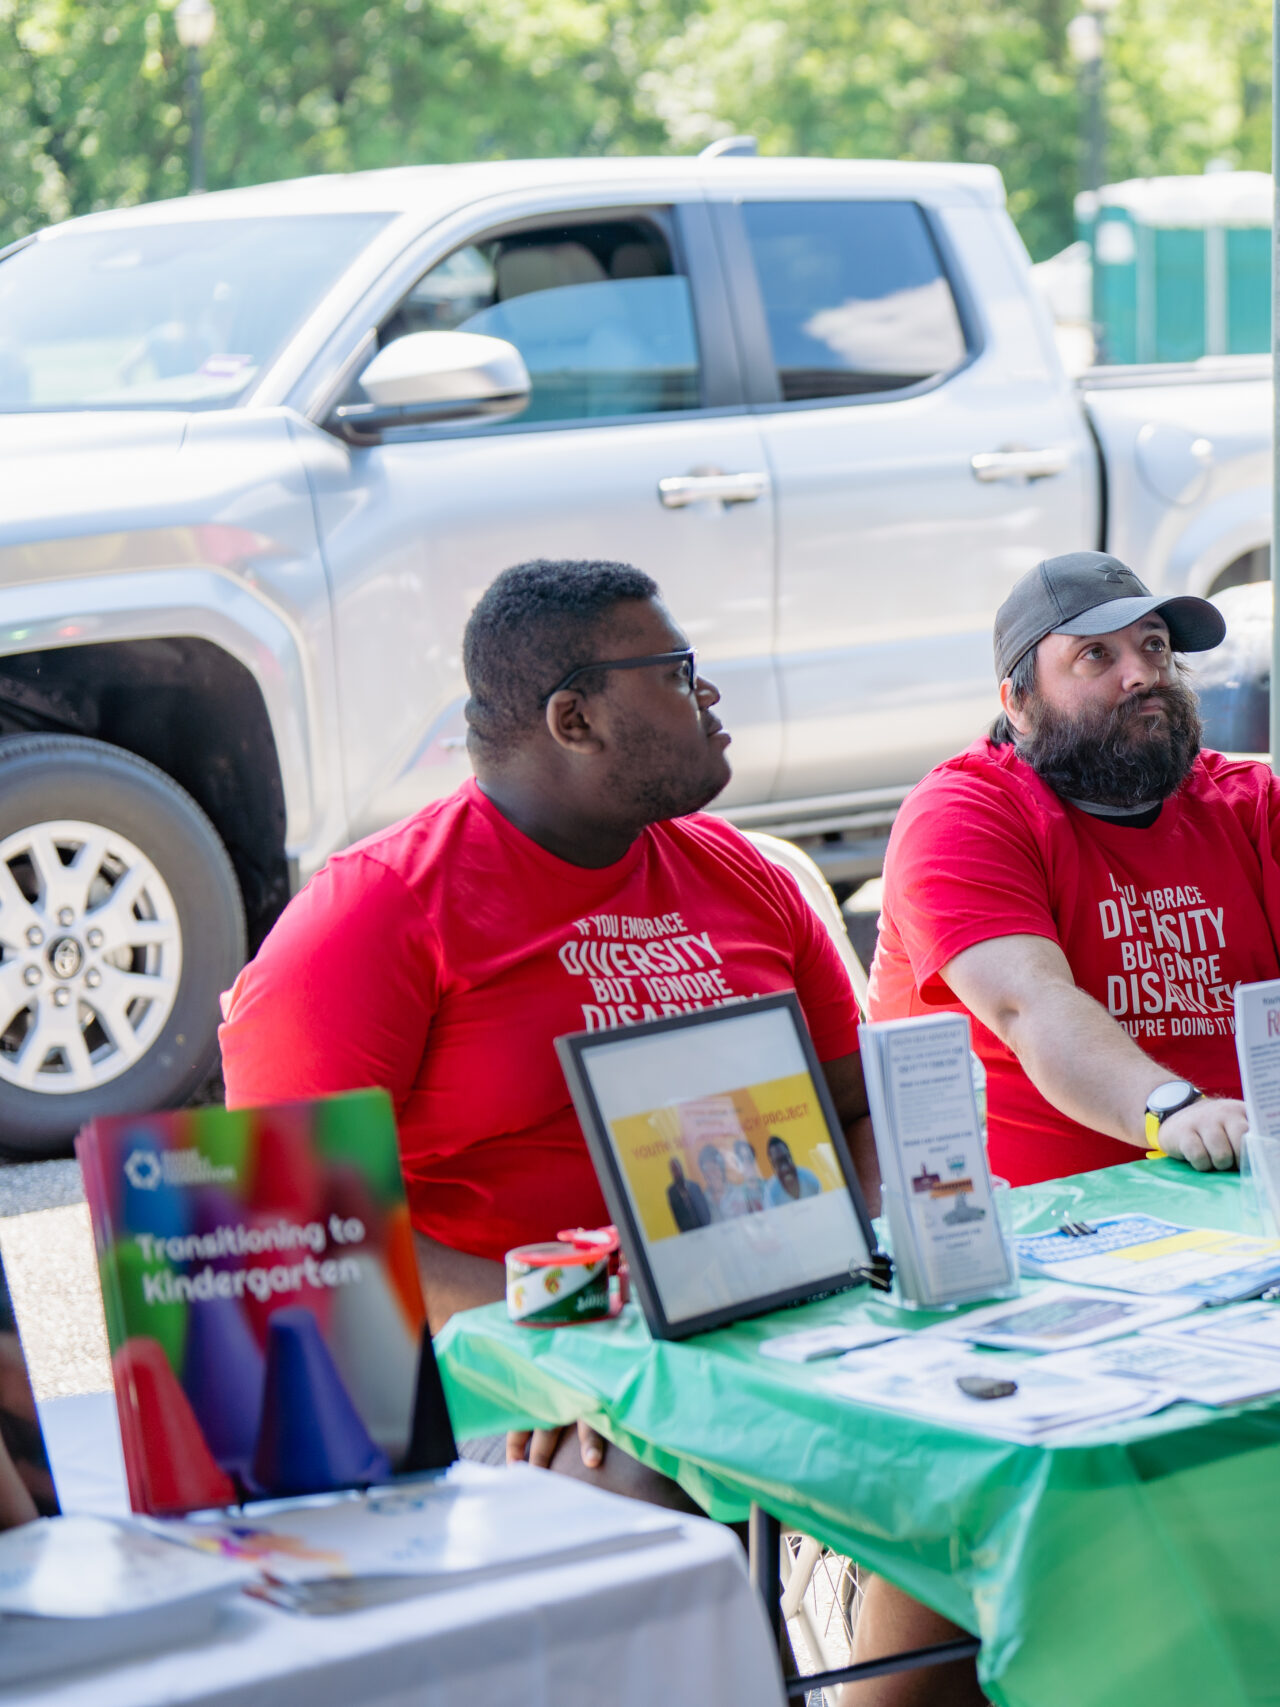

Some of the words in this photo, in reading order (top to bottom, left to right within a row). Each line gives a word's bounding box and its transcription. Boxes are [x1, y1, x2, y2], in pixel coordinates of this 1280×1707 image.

[572, 918, 590, 936] IF
[588, 914, 619, 938] YOU
[621, 911, 689, 940] EMBRACE
[558, 931, 724, 977] DIVERSITY
[588, 977, 638, 1004] BUT
[640, 968, 734, 1002] IGNORE
[1120, 1018, 1166, 1038] OU'RE
[1171, 1014, 1215, 1037] DOING
[1215, 1016, 1228, 1036] IT
[134, 1218, 327, 1263] Transitioning
[328, 1213, 367, 1245] to
[142, 1255, 362, 1305] Kindergarten
